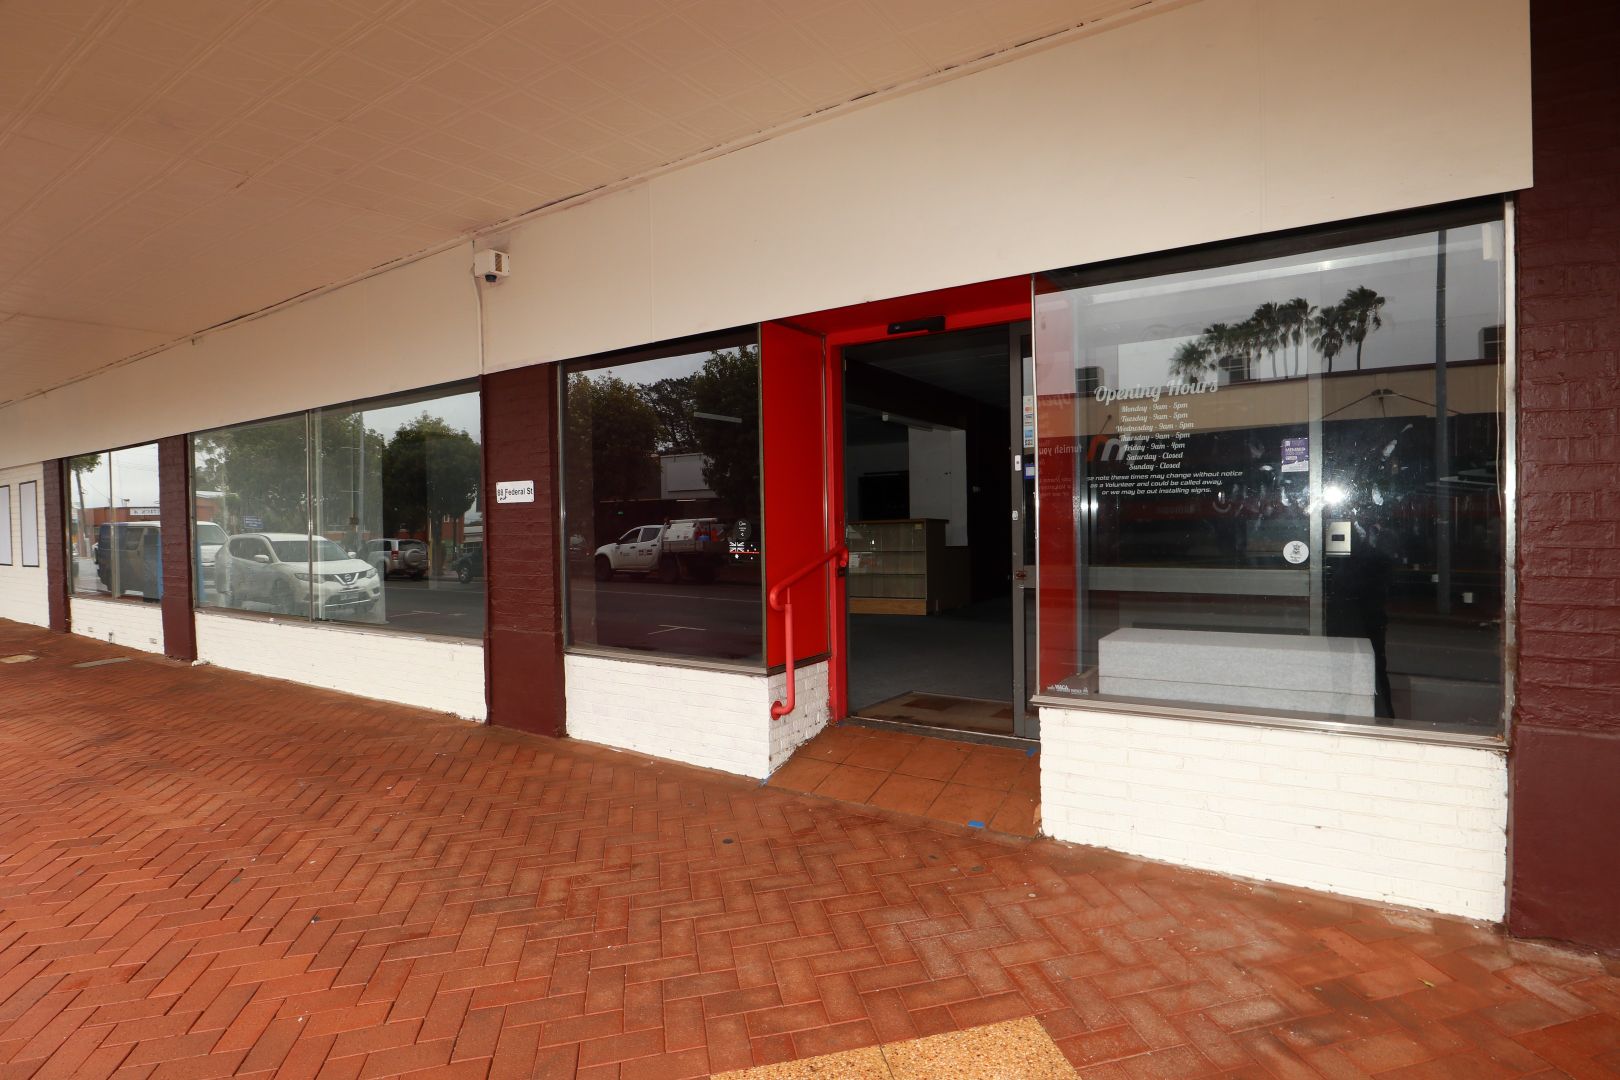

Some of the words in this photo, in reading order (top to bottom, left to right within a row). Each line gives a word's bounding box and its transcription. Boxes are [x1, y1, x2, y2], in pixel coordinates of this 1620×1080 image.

[1094, 384, 1160, 406] Opening
[1167, 380, 1218, 396] Hours
[1121, 405, 1147, 413] Monday
[1173, 402, 1188, 410] 5pm
[1120, 414, 1148, 422] Tuesday
[1173, 412, 1188, 420] 5pm
[1116, 424, 1153, 432] Wednesday
[1176, 432, 1190, 440] 5pm
[1171, 442, 1185, 450] 4pm
[505, 488, 525, 496] Federal
